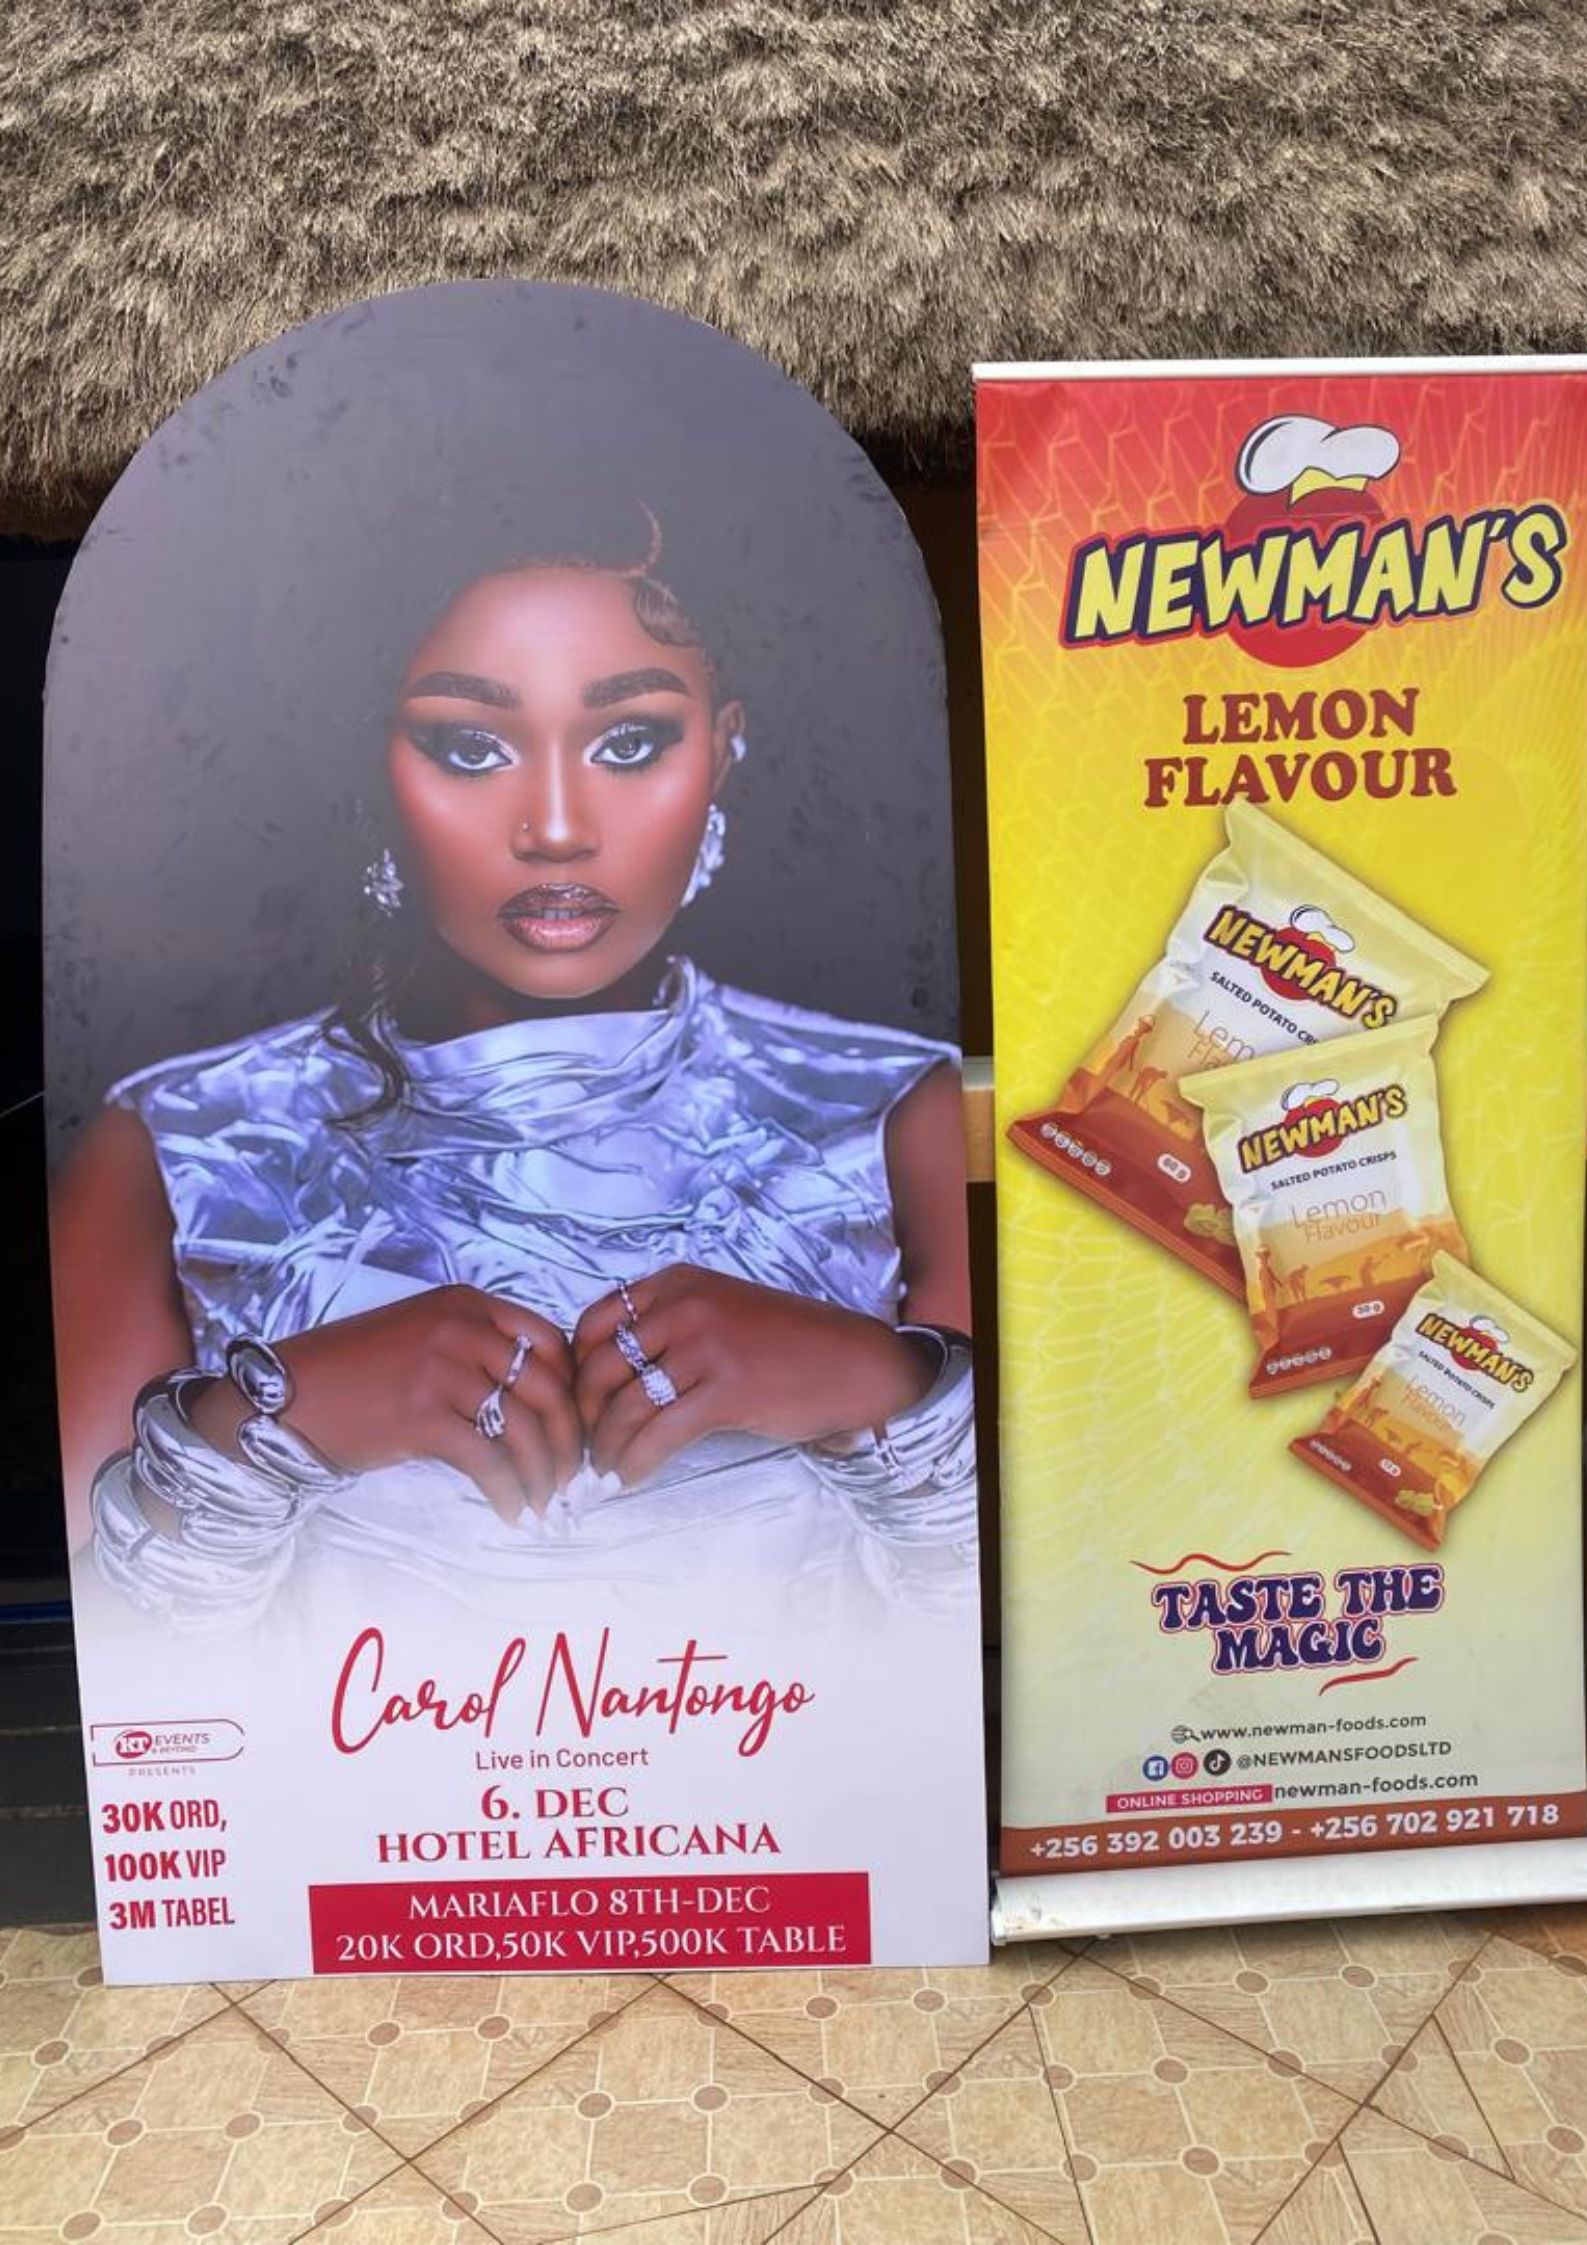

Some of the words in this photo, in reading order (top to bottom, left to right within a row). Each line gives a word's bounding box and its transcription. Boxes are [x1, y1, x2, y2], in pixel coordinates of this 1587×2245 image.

[1062, 502, 1567, 648] NEWMAN'S
[1183, 688, 1419, 745] LEMON
[1144, 748, 1457, 807] FLAVOUR
[1203, 904, 1398, 1030] NEWMAN'S
[1210, 970, 1253, 1004] SALTED
[1252, 998, 1298, 1034] POTATO
[1236, 1083, 1408, 1174] NEWMAN'S
[1270, 1173, 1312, 1191] SALTED
[1312, 1161, 1358, 1180] POTATO
[1358, 1151, 1398, 1168] CRISPS
[1291, 1189, 1388, 1228] Lemon
[1303, 1212, 1381, 1242] Flavour
[1152, 1573, 1325, 1634] TASTE
[1335, 1562, 1445, 1617] THE
[1212, 1617, 1387, 1675] MAGIC
[331, 1627, 526, 1755] Carol
[536, 1627, 815, 1758] Nantongo
[155, 1733, 210, 1746] EVENTS
[1200, 1714, 1427, 1741] www.newman-foods.com
[128, 1766, 196, 1776] PRESENTS
[475, 1751, 523, 1770] Live
[529, 1749, 550, 1768] in
[556, 1746, 649, 1768] Concert
[1236, 1741, 1452, 1769] @NEWMANSFOODSLTD
[480, 1785, 521, 1819] 6.
[535, 1786, 629, 1818] DEC
[1117, 1794, 1177, 1809] ONLINE
[1181, 1788, 1263, 1805] SHOPPING
[1274, 1772, 1479, 1800] newman-foods.com
[101, 1802, 165, 1834] 30K
[170, 1800, 227, 1832] ORD,
[1031, 1835, 1098, 1859] +256
[1107, 1831, 1160, 1853] 392
[1168, 1825, 1221, 1849] 003
[1229, 1821, 1283, 1846] 239
[1310, 1815, 1378, 1840] +256
[1386, 1810, 1438, 1834] 702
[1446, 1806, 1495, 1831] 921
[1507, 1803, 1560, 1827] 718
[377, 1831, 530, 1863] HOTEL
[544, 1823, 781, 1857] AFRICANA
[104, 1852, 181, 1882] 100K
[188, 1849, 226, 1878] VIP
[109, 1902, 156, 1930] 3M
[162, 1897, 235, 1927] TABEL
[407, 1889, 600, 1920] MARIAFLO
[608, 1886, 771, 1917] 8TH-DEC
[337, 1934, 400, 1961] 20K
[413, 1930, 564, 1961] ORD,50K
[575, 1927, 727, 1959] VIP,500K
[735, 1924, 848, 1954] TABLE
